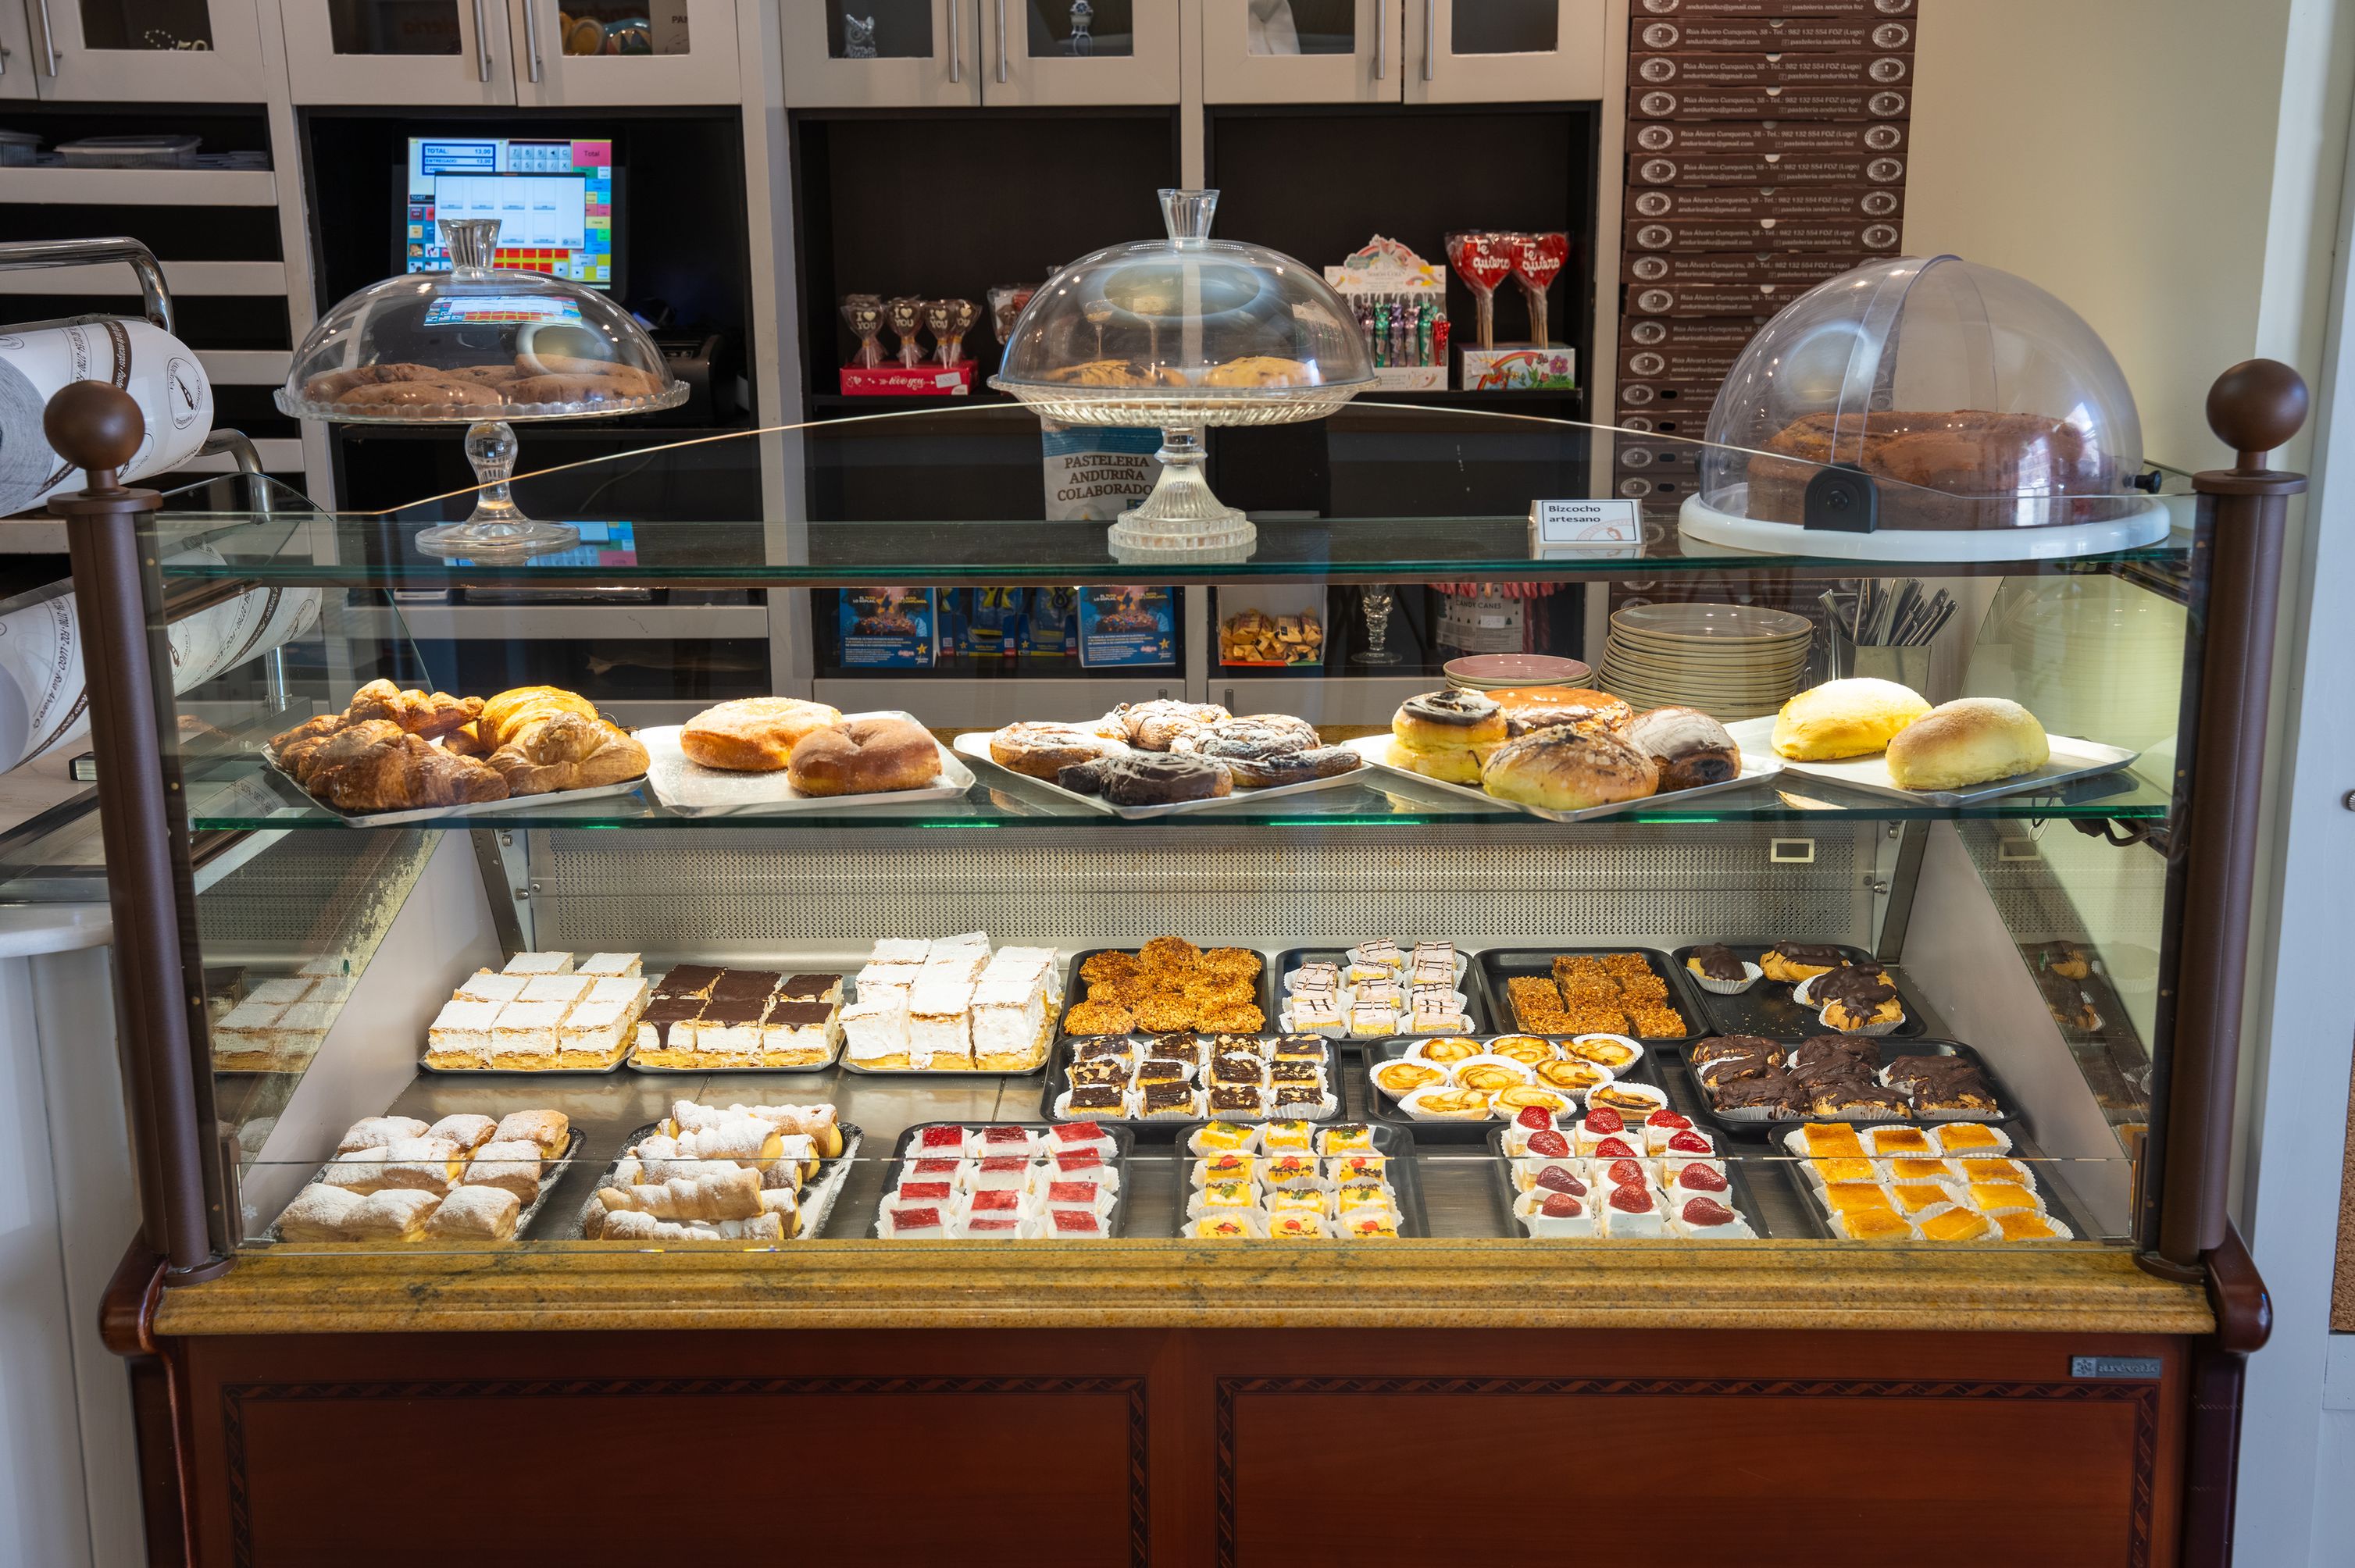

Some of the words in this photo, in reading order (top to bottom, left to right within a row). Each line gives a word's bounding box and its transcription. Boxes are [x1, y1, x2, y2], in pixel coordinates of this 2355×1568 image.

[1463, 235, 1489, 255] Te
[1512, 239, 1537, 261] Te
[1473, 255, 1511, 275] quiero
[1522, 256, 1560, 277] quiero
[894, 319, 914, 327] YOU
[930, 319, 947, 329] YOU
[956, 318, 970, 326] OU
[116, 369, 127, 389] Paste
[1064, 455, 1150, 469] PASTELERIA
[1069, 469, 1146, 484] ANDURIÑA
[1058, 484, 1155, 501] COLABORADO
[60, 629, 69, 644] FOZ
[227, 631, 236, 649] FOZ
[58, 647, 68, 671] LUGO
